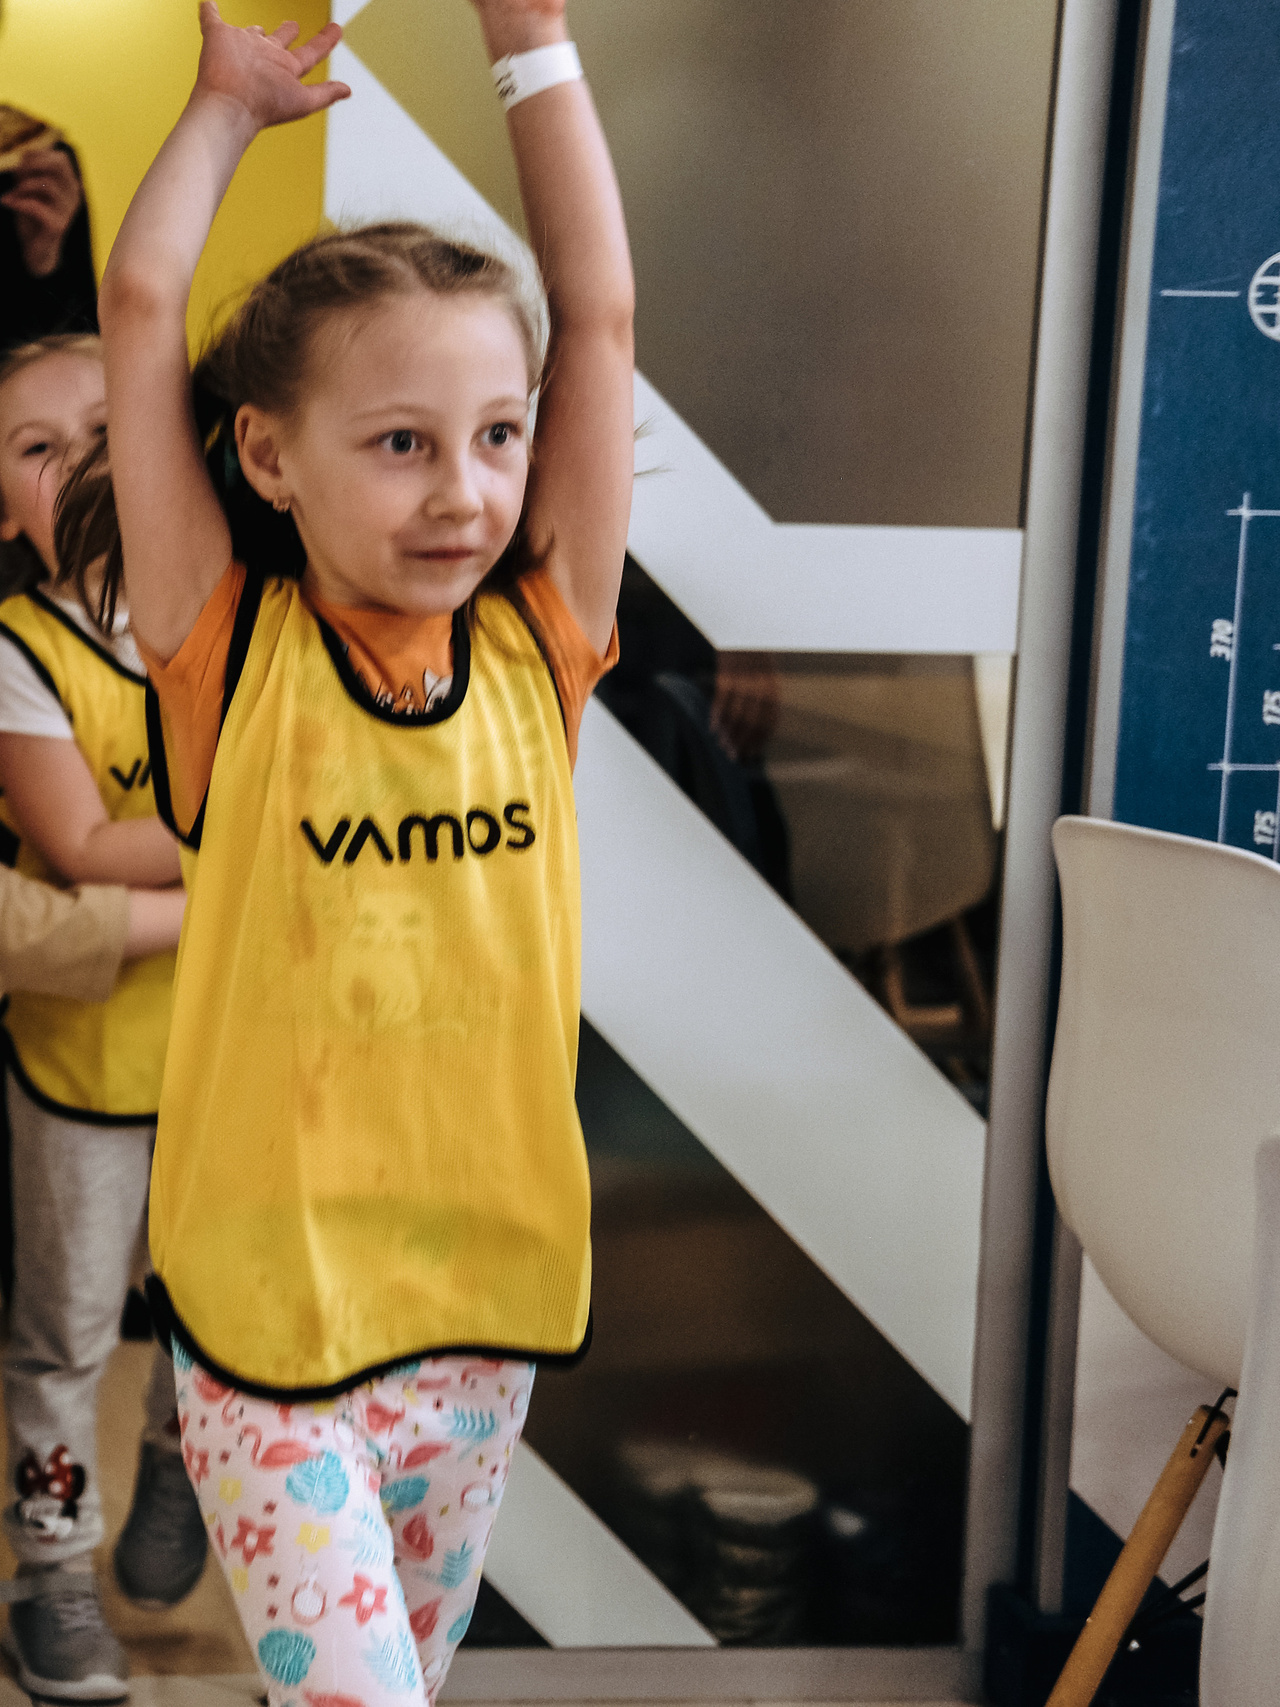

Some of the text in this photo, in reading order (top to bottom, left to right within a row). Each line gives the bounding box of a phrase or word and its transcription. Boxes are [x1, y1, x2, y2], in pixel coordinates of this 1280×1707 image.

[1210, 618, 1234, 662] 370
[300, 800, 536, 865] VAMOS
[1253, 809, 1276, 845] 175
